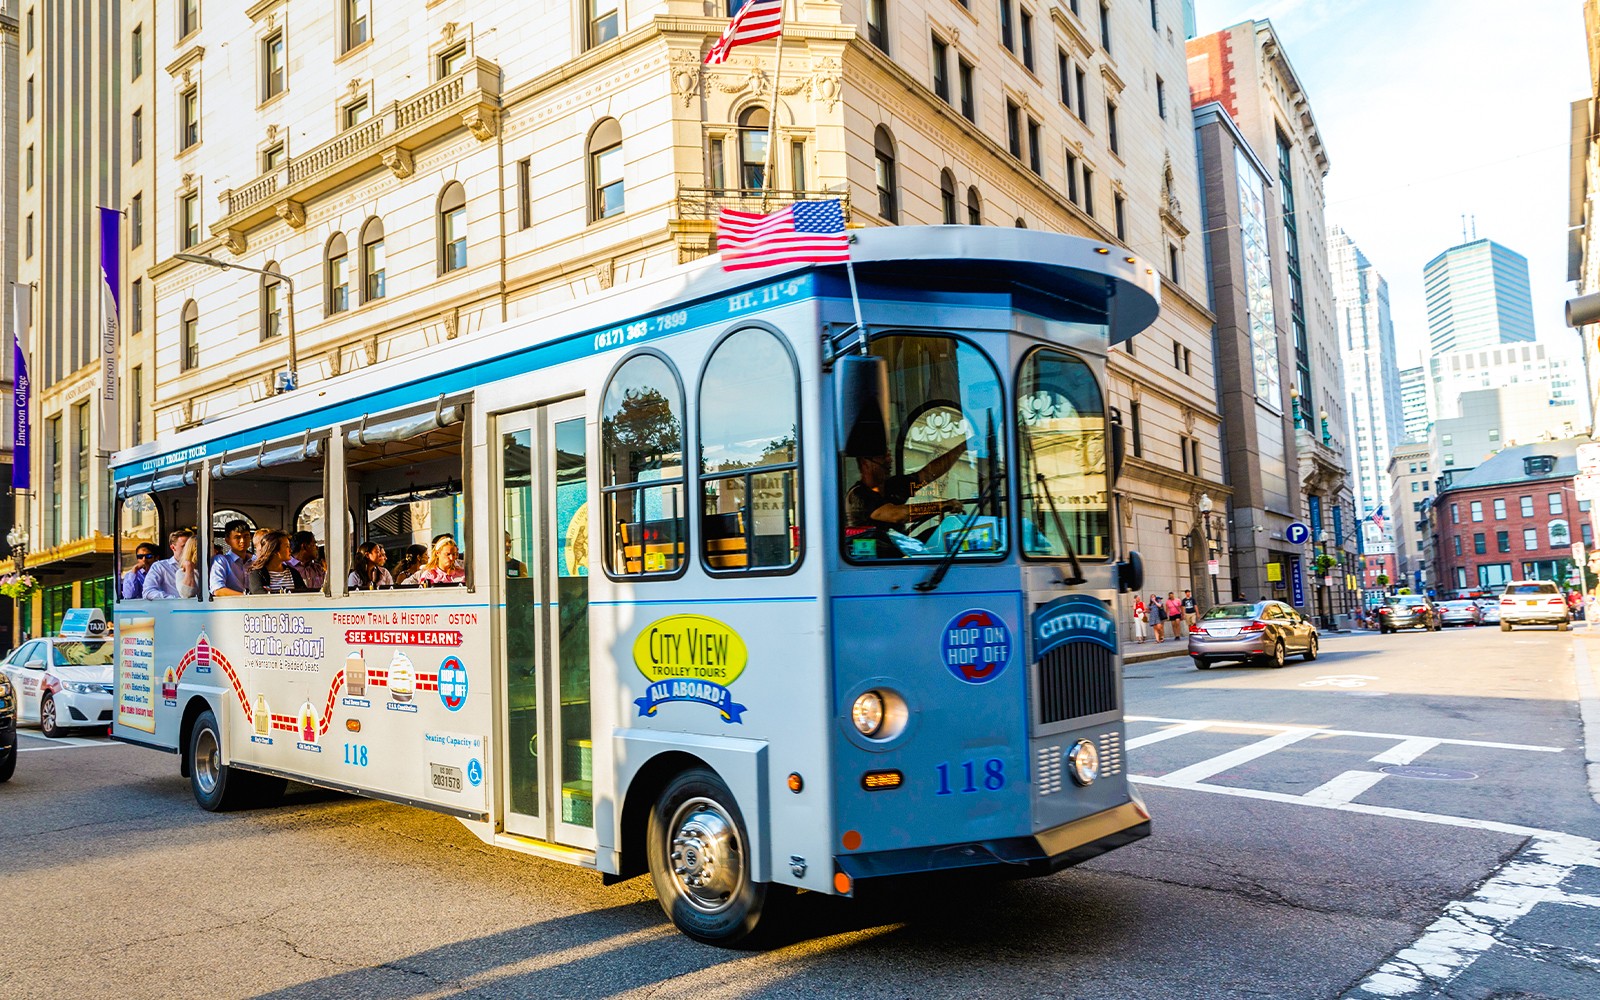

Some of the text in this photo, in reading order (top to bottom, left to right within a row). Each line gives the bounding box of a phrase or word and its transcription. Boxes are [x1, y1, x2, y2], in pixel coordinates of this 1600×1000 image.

[728, 295, 757, 312] HT.
[594, 332, 623, 350] (617)
[657, 310, 687, 332] 7899
[104, 317, 116, 400] Emerson College
[16, 375, 27, 446] Emerson College
[166, 450, 188, 464] TROLLEY
[189, 445, 206, 458] TOURS
[1292, 526, 1304, 541] P
[1293, 564, 1301, 598] PARKING
[244, 613, 312, 634] See the Sies...
[392, 612, 398, 624] &
[448, 613, 478, 625] OSTON
[1040, 612, 1111, 638] CITYVIEW
[266, 636, 282, 656] the
[349, 632, 458, 644] SEE LISTEN LEARN!
[949, 627, 1004, 646] HOP ON
[650, 628, 728, 666] CITY VIEW
[948, 645, 1008, 664] HOP OFF
[285, 660, 303, 670] Padded
[304, 662, 319, 672] Seats
[652, 666, 726, 678] TROLLEY TOURS
[651, 682, 726, 705] ALL ABOARD!
[425, 734, 445, 745] Seating
[446, 736, 471, 748] Capacity
[344, 743, 368, 767] 118
[434, 774, 460, 789] 2031578
[934, 758, 1006, 795] 118
